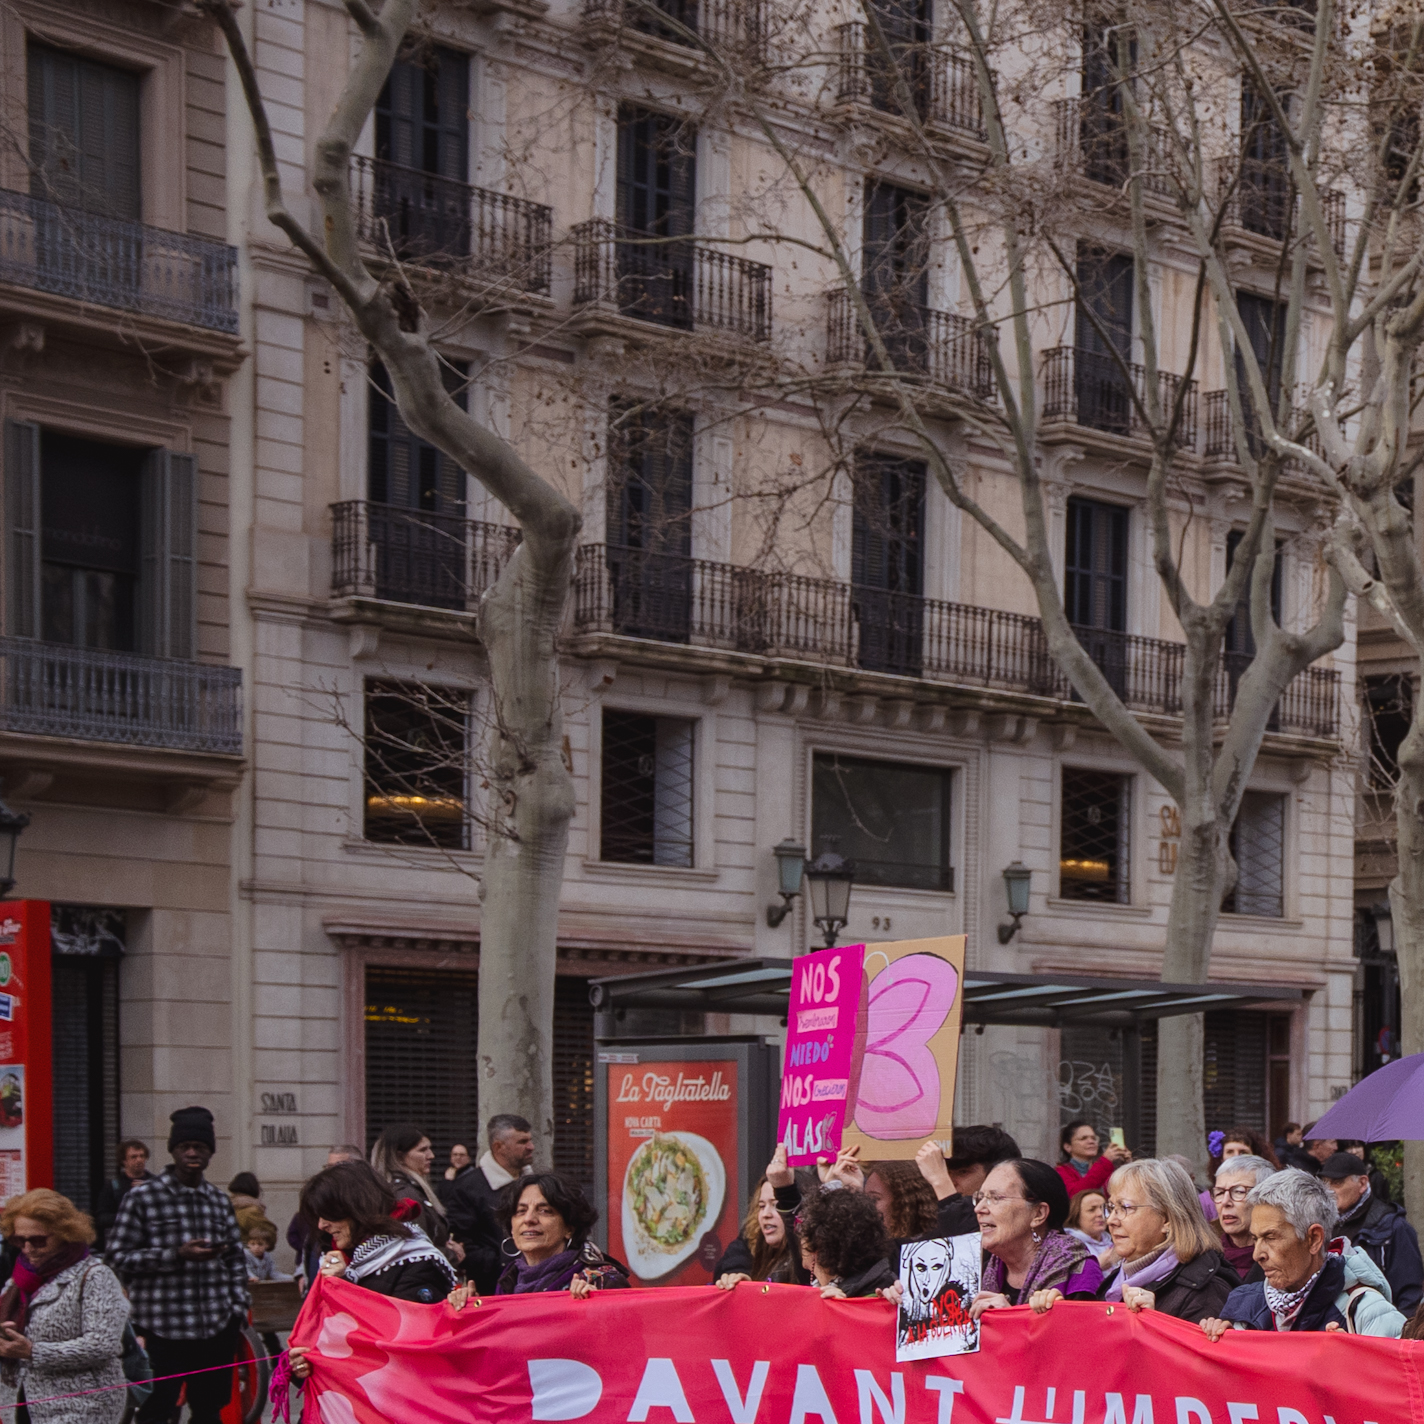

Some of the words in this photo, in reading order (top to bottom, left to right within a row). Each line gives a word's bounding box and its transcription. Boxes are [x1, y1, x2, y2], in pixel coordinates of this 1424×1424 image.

[872, 917, 891, 931] 93
[800, 955, 841, 1004] NOS
[790, 1043, 829, 1068] MIEDO
[260, 1091, 297, 1112] SANTA
[616, 1073, 642, 1102] La
[642, 1071, 731, 1112] Tagliatella
[781, 1074, 814, 1109] NOS
[783, 1116, 824, 1157] ALAS
